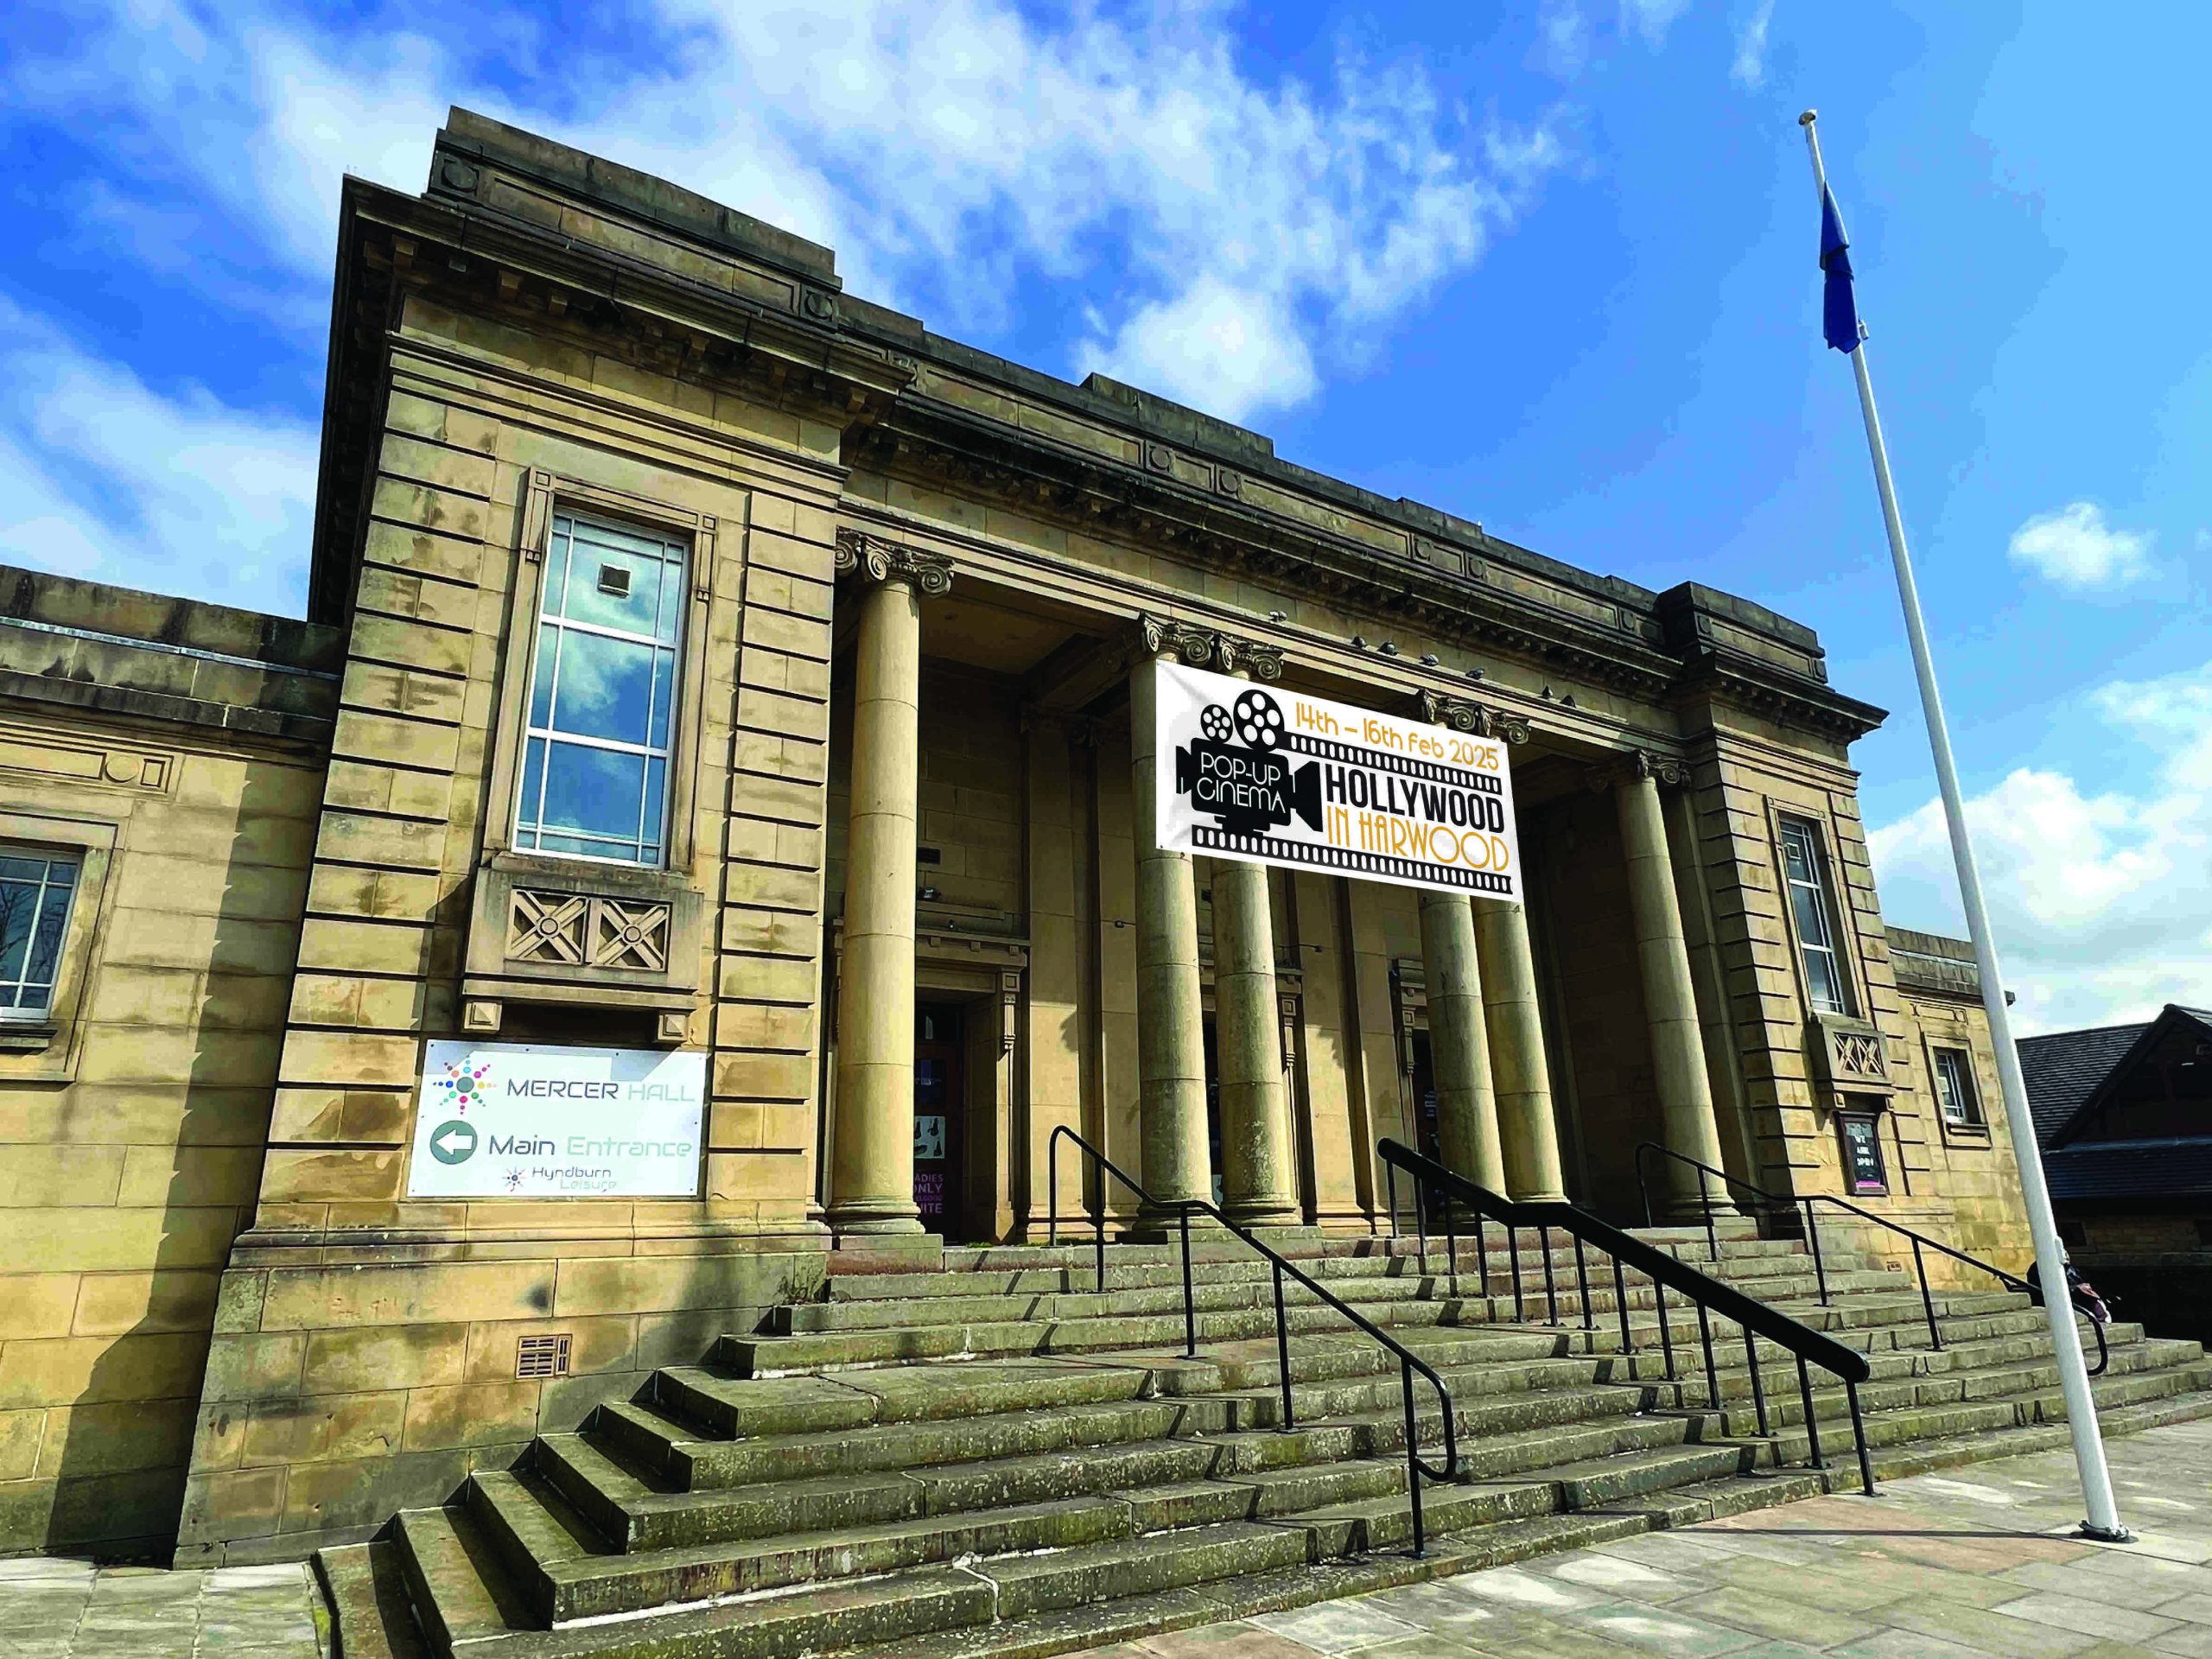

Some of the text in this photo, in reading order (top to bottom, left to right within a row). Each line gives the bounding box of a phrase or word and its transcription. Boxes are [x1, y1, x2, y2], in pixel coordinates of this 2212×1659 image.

[1295, 701, 1339, 736] 14th
[1363, 717, 1404, 751] 16th
[1448, 738, 1500, 772] 2025
[1200, 752, 1281, 787] POP-UP
[1197, 778, 1287, 814] CINEMA
[1325, 763, 1505, 834] HOLLYWOOD
[1326, 805, 1510, 873] IN HARWOOD
[507, 1078, 696, 1102] MERCER HALL
[488, 1134, 692, 1157] Main Entrance
[532, 1166, 612, 1181] Hyndburn
[560, 1179, 617, 1190] Leisure
[914, 1173, 944, 1183] ADIES
